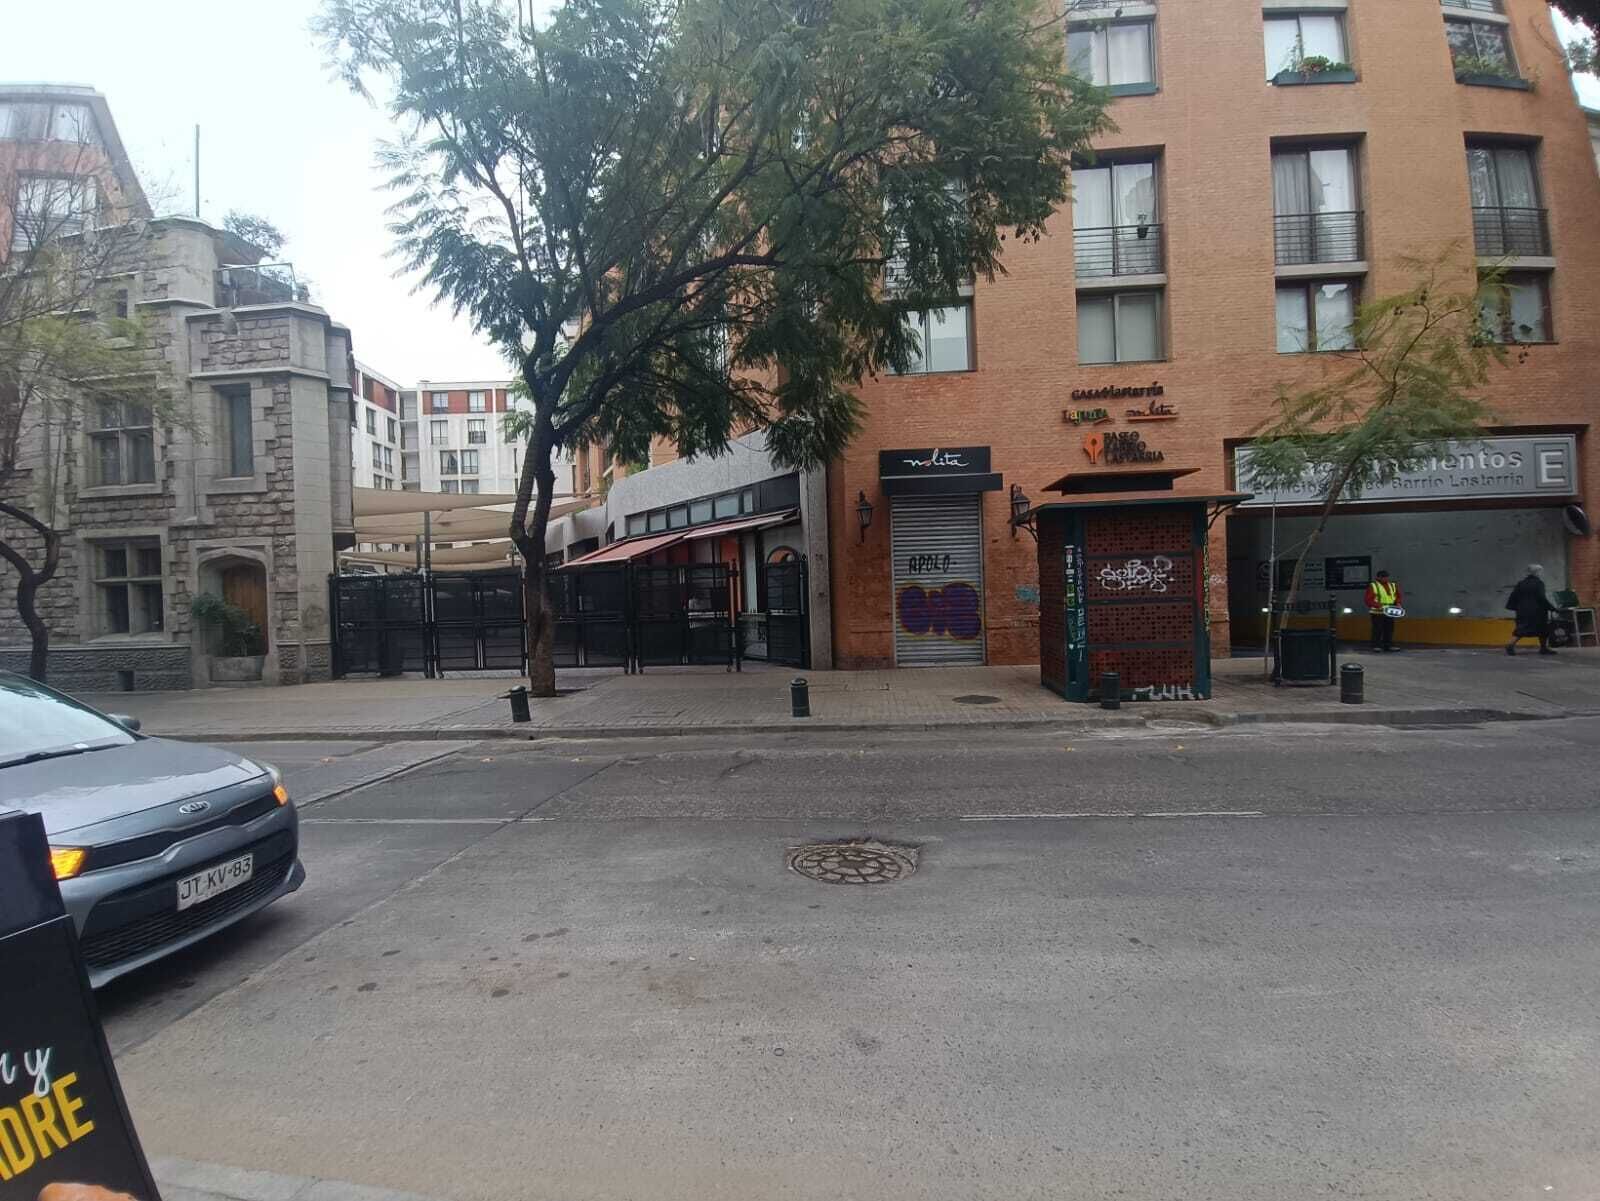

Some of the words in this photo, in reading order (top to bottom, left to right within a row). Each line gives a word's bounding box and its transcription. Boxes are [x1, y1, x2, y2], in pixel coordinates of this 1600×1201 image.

[903, 448, 970, 467] nolita
[1539, 449, 1566, 484] E
[1391, 475, 1445, 489] Barrio
[1450, 472, 1525, 488] Lastarria
